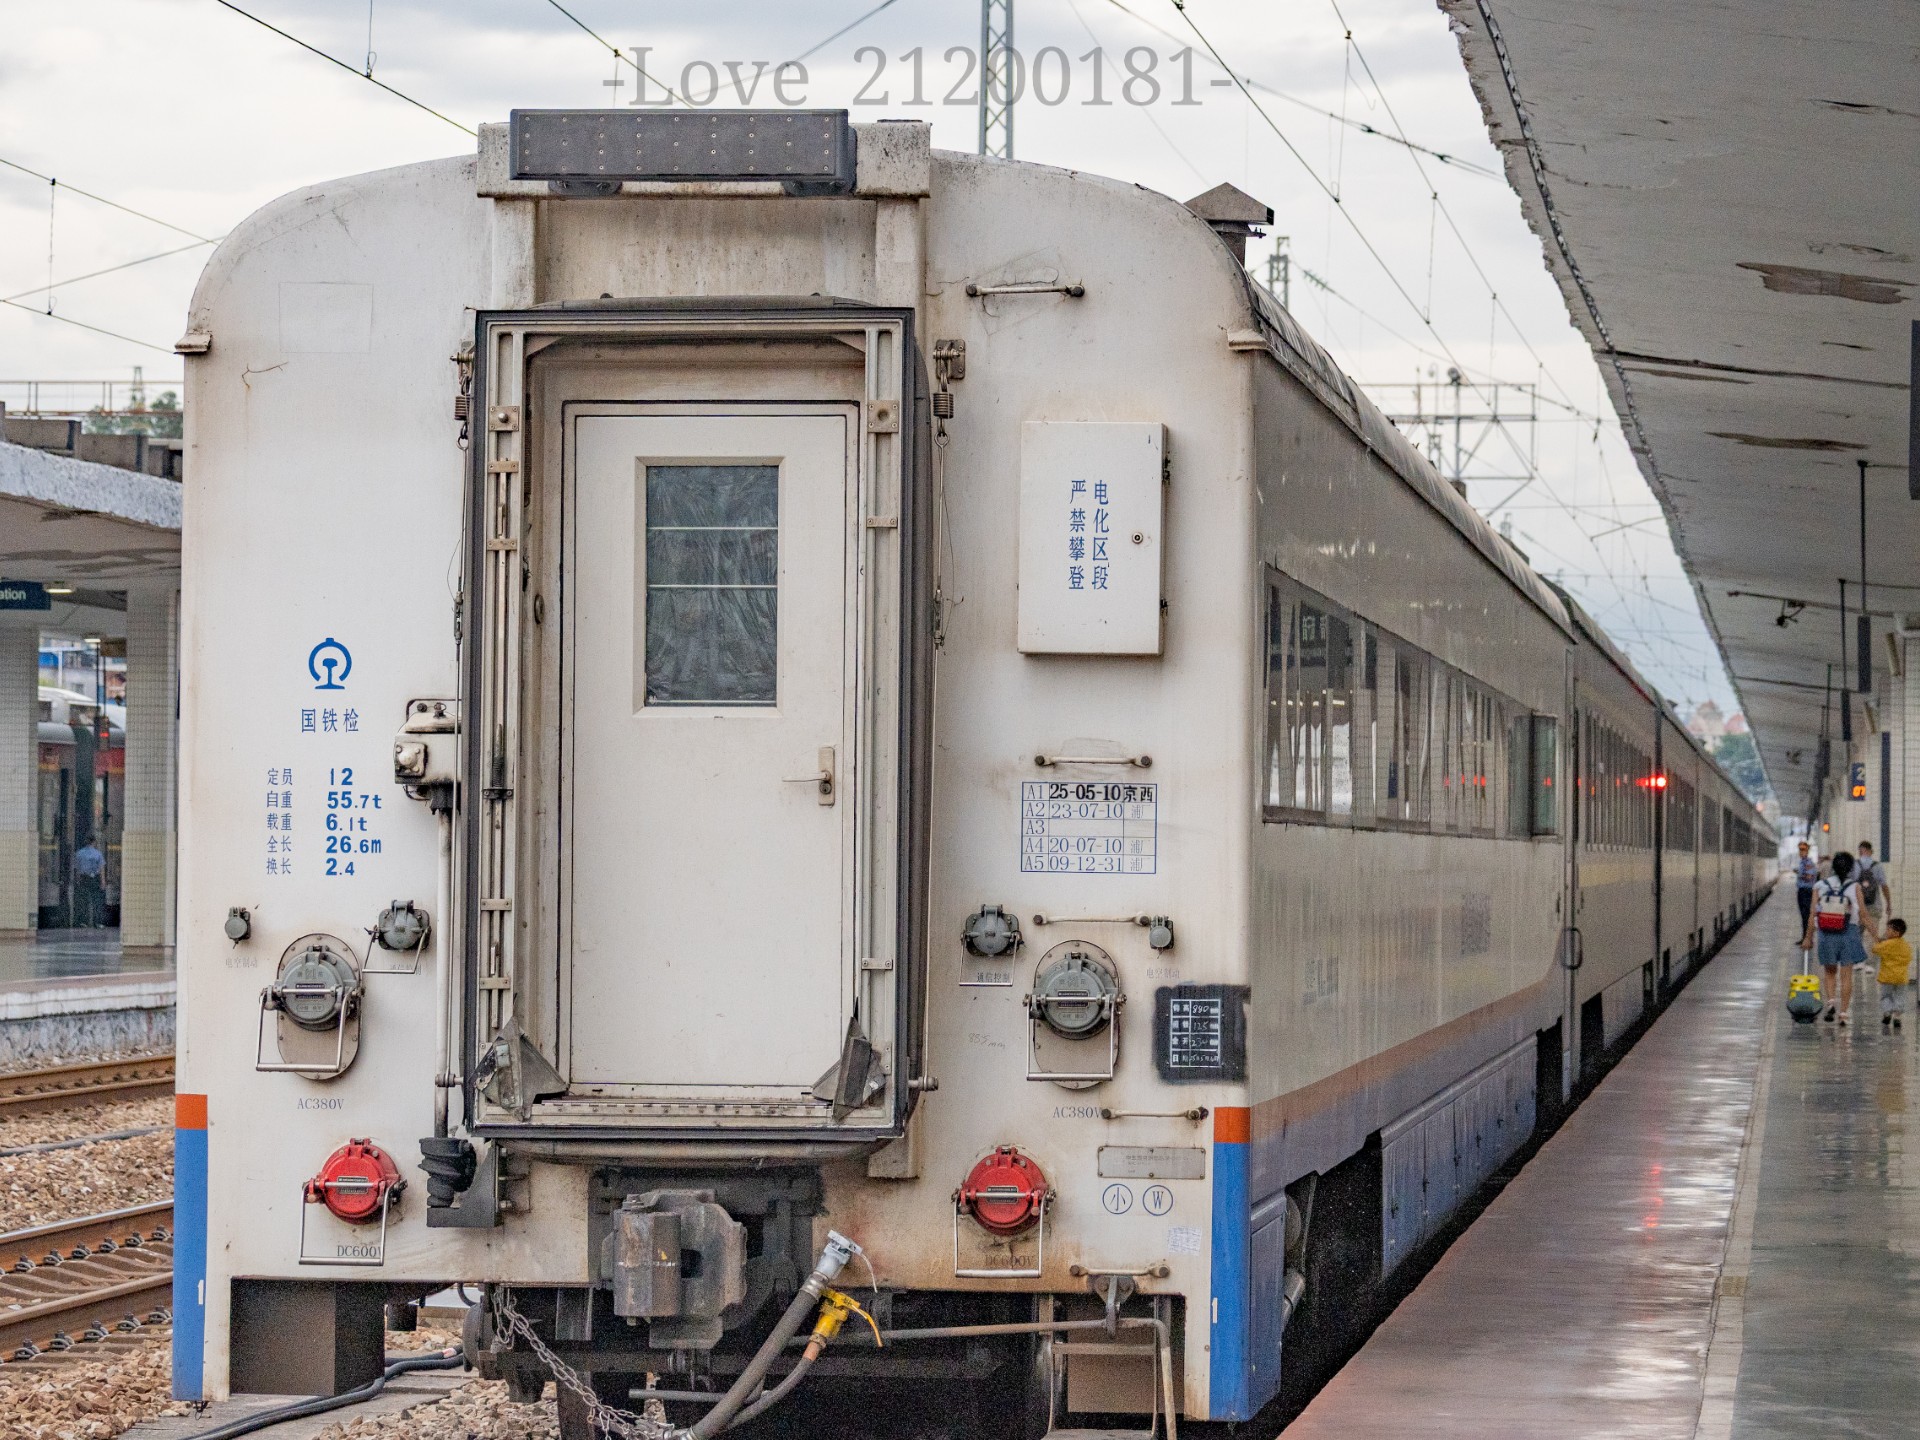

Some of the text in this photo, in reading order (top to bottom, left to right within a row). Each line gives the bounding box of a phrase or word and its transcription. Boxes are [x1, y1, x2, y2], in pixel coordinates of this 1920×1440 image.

[1068, 479, 1087, 590] 严禁攀登
[1092, 479, 1110, 590] 电化区段
[301, 708, 359, 733] 国铁检
[267, 767, 353, 786] 定员 12
[266, 790, 382, 809] 自重 55.7t
[1027, 784, 1153, 802] A1 25-05-10 京西
[1025, 802, 1045, 817] A2
[1051, 803, 1123, 819] 23-07-10
[266, 813, 367, 831] 载重 6.1t
[1025, 820, 1045, 835] A3
[266, 835, 382, 854] 全长 26.6m
[1025, 838, 1044, 853] A4
[1049, 837, 1122, 854] 20-07-10
[266, 857, 355, 876] 换长 2.4
[1024, 856, 1044, 871] A5
[1049, 856, 1121, 872] 09-12-31
[297, 1098, 344, 1110] AC380V
[1053, 1106, 1101, 1119] AC380V
